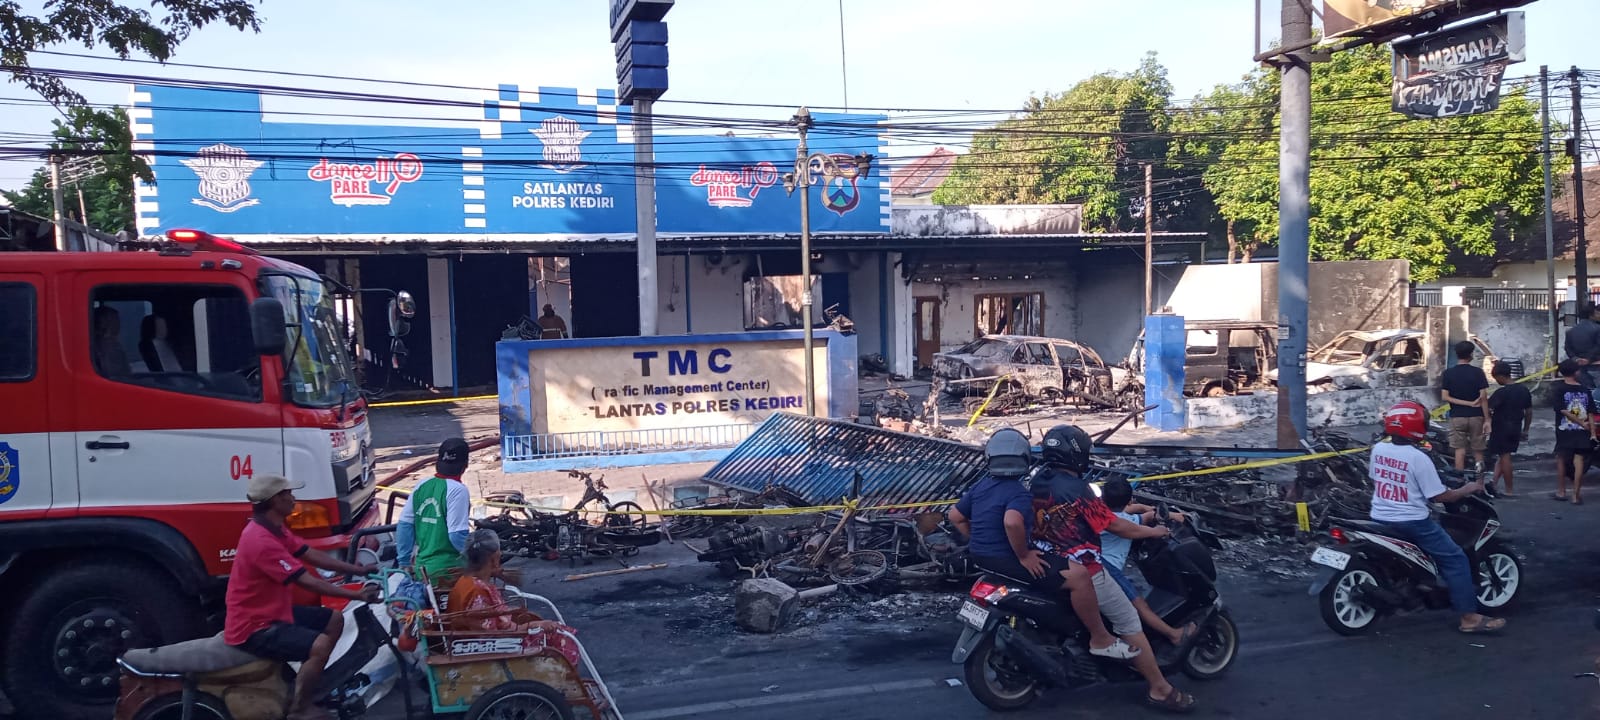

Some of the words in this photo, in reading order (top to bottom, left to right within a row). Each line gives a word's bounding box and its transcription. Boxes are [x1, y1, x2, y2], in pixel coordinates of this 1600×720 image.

[333, 180, 368, 194] PARE
[523, 182, 603, 195] SATLANTAS
[709, 185, 736, 197] PARE
[512, 196, 566, 209] POLRES
[570, 196, 614, 209] KEDIRI
[643, 382, 723, 397] Management
[726, 379, 770, 392] Center)
[673, 398, 740, 415] POLRES
[745, 396, 803, 411] KEDIRI
[230, 454, 254, 480] 04
[1375, 455, 1409, 472] SAMBEL
[1375, 467, 1408, 484] PECEL
